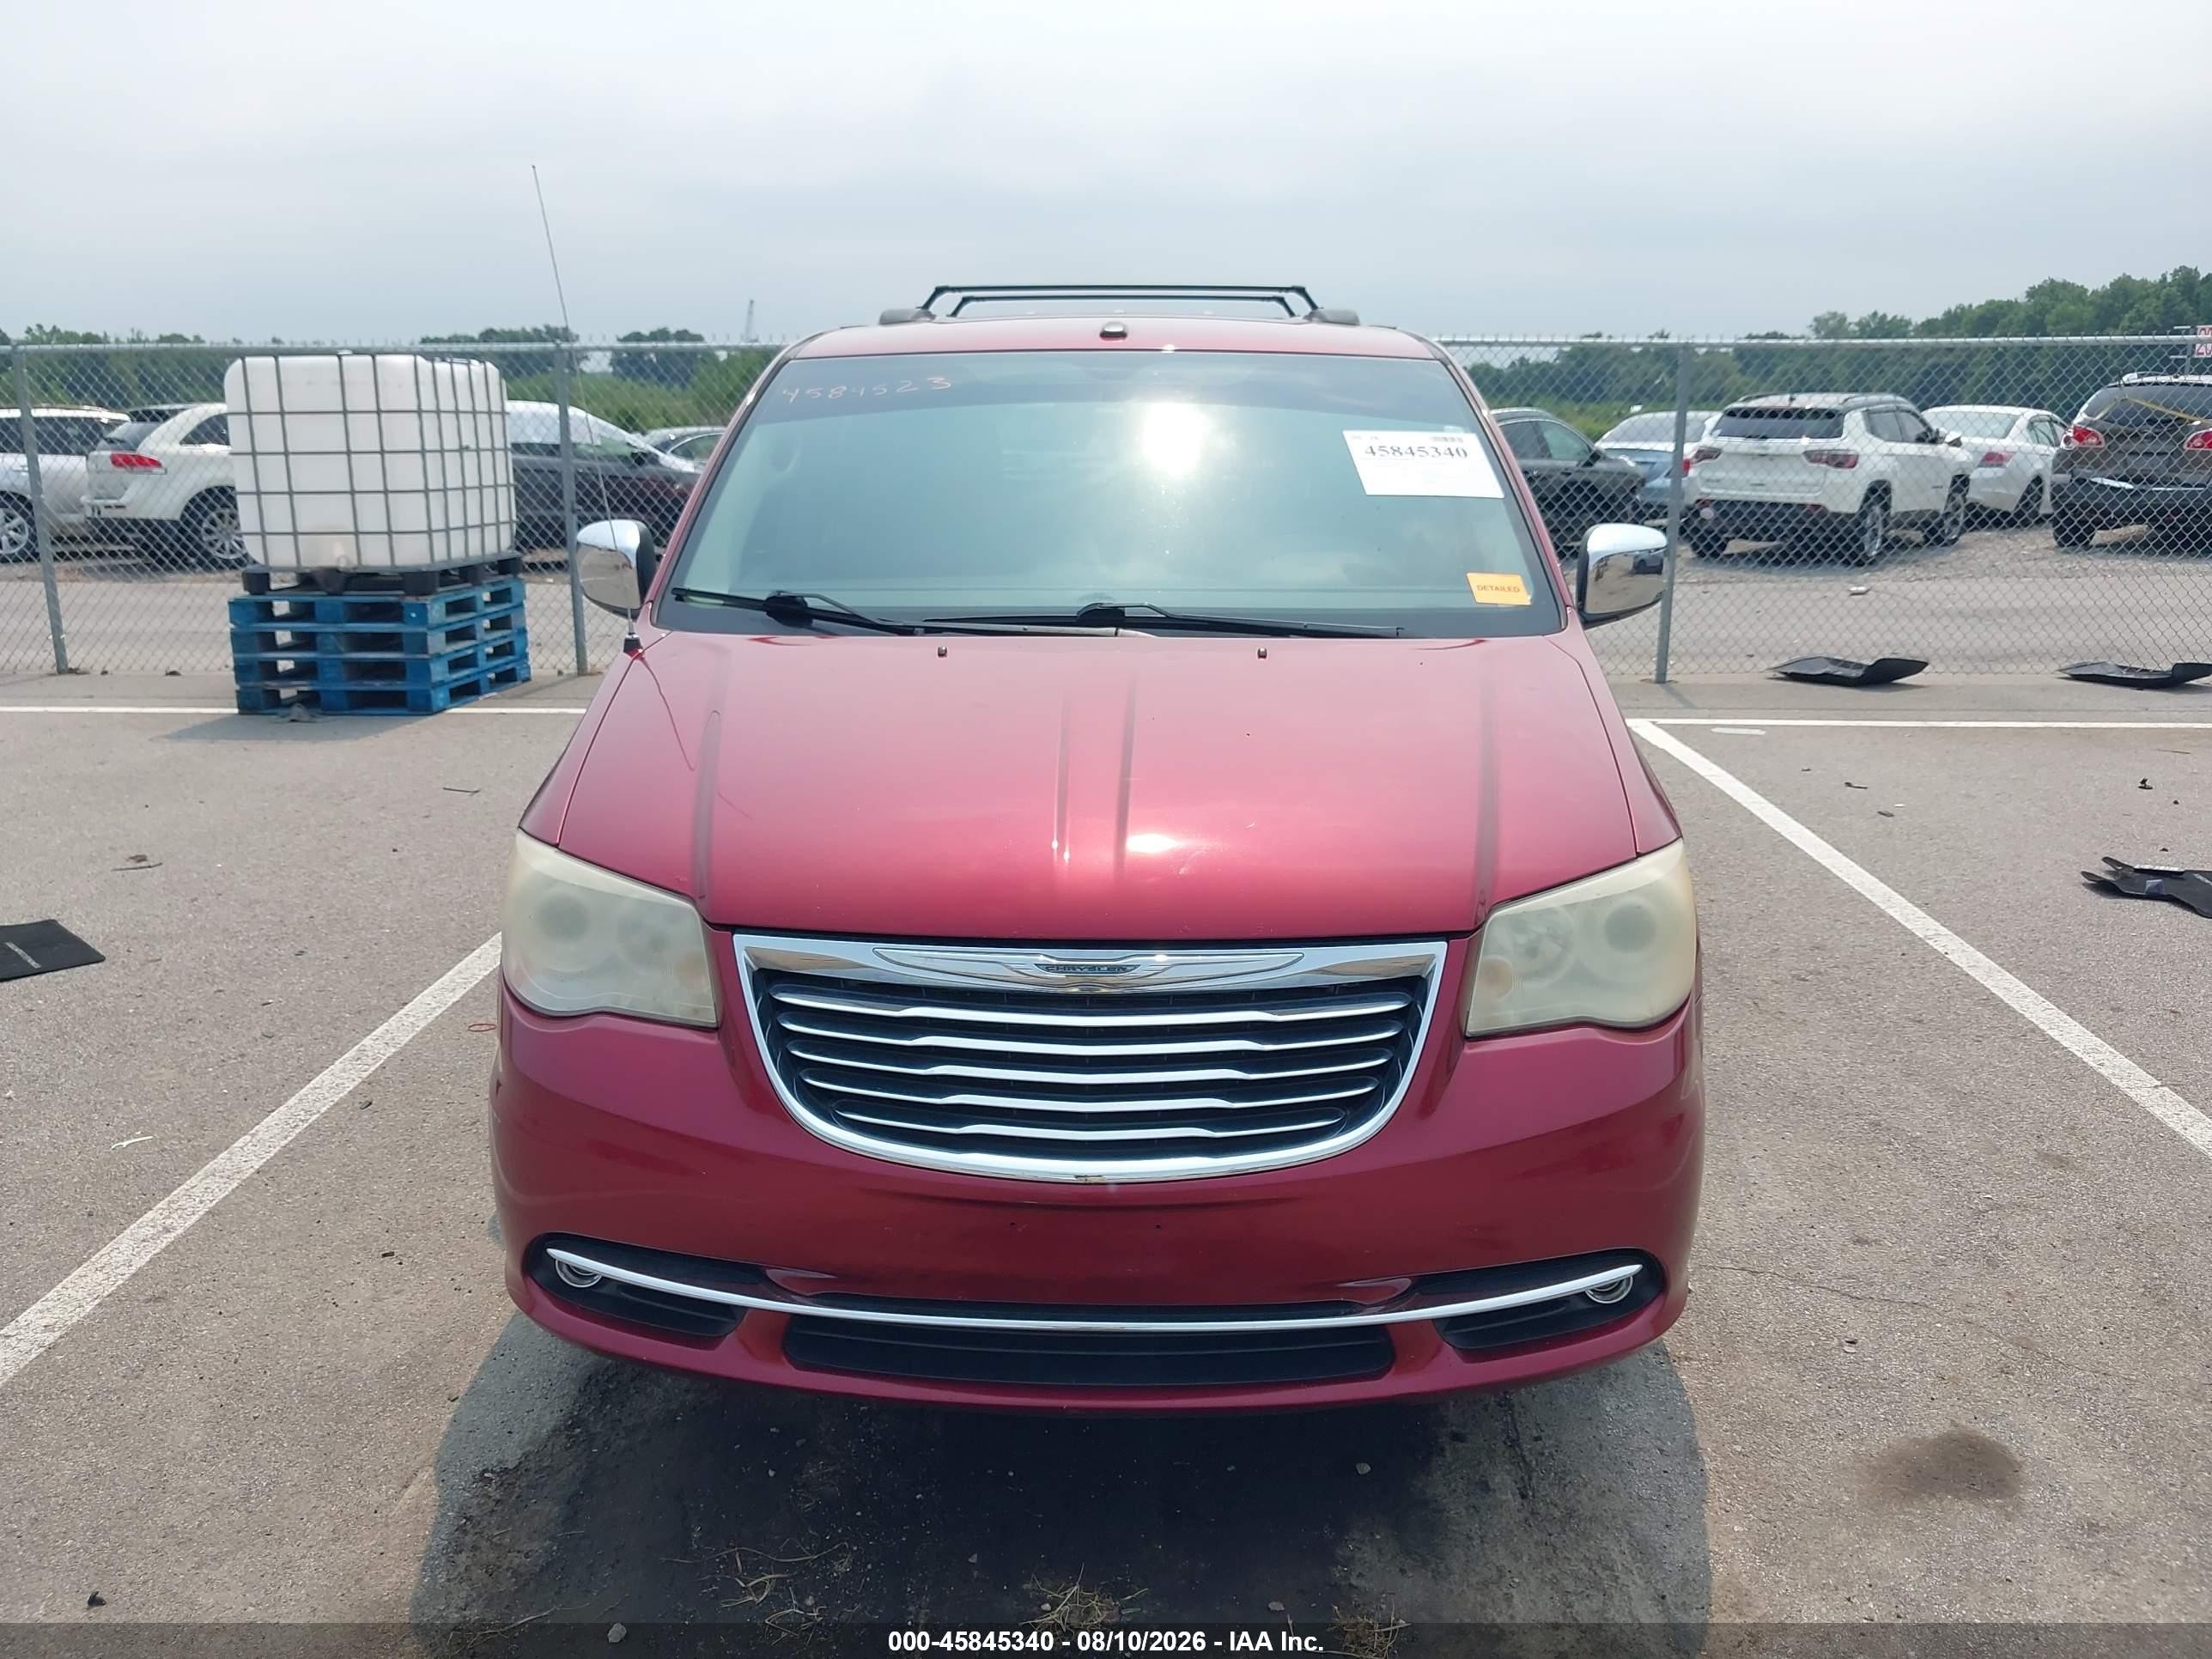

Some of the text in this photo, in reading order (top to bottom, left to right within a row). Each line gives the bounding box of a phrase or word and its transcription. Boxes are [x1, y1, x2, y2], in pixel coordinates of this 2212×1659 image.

[1364, 446, 1468, 459] 45845340
[1476, 584, 1521, 593] DETAILED
[1045, 964, 1128, 973] CHRYSLER
